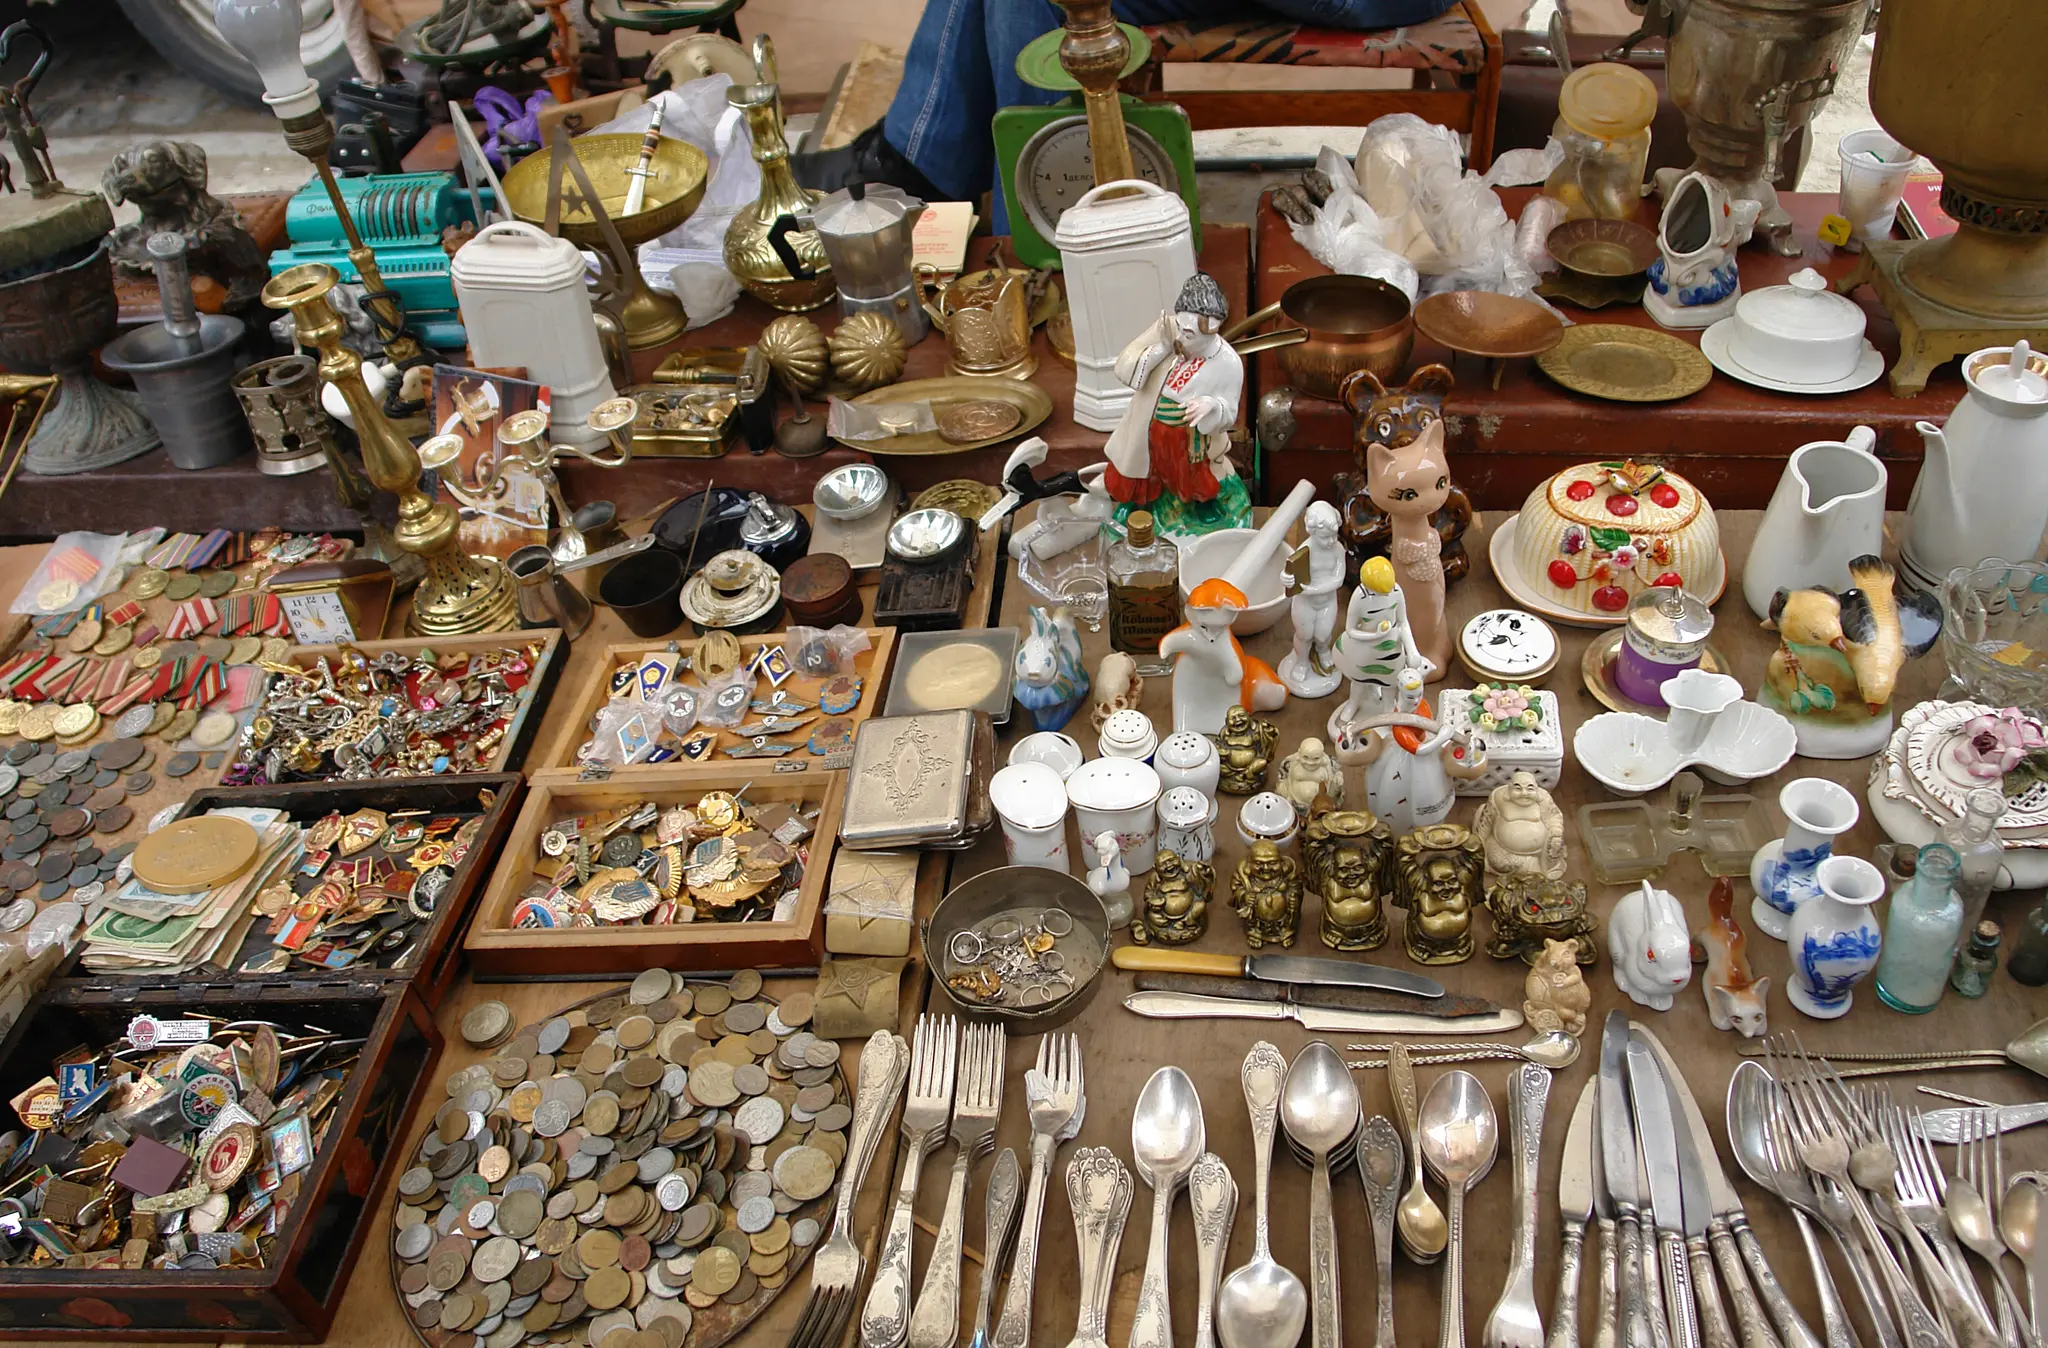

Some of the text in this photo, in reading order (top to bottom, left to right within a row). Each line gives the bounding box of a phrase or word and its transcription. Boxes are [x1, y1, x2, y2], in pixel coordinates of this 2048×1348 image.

[306, 596, 316, 604] 12
[322, 596, 328, 604] 1
[338, 616, 347, 624] 3
[807, 655, 822, 667] 2
[615, 673, 629, 686] 3
[690, 741, 702, 754] 3
